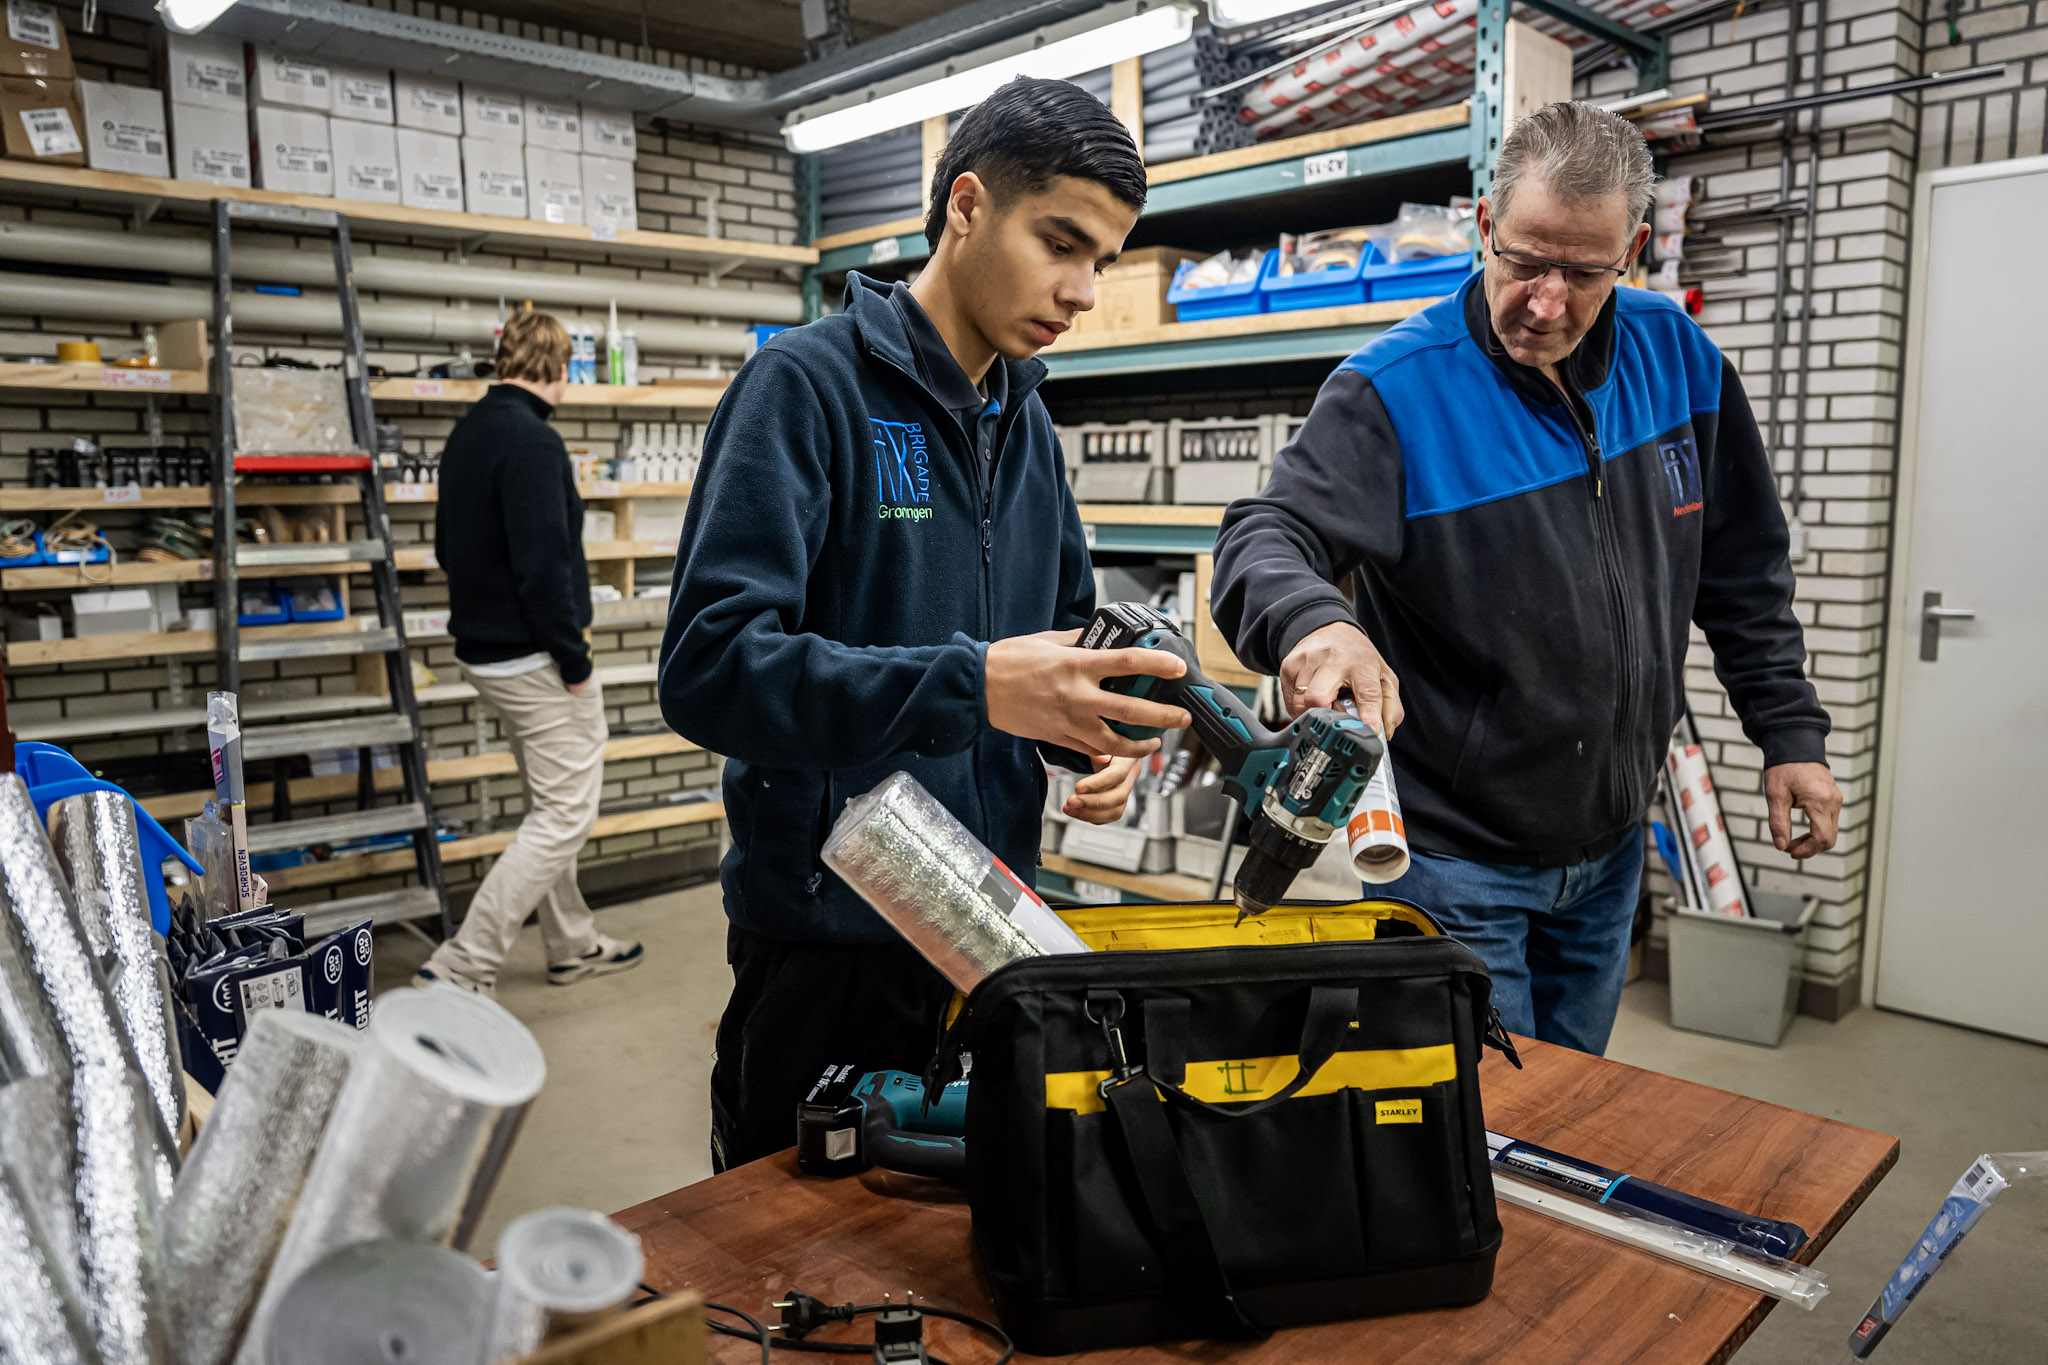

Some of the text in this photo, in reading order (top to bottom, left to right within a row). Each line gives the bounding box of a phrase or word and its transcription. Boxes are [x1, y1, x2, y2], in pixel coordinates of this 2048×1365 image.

[904, 422, 930, 503] BRIGADE
[237, 849, 250, 898] SCHROEVEN
[358, 938, 367, 961] 100
[364, 937, 371, 954] CM
[328, 956, 337, 979] 100
[1380, 1107, 1418, 1117] STANLEY
